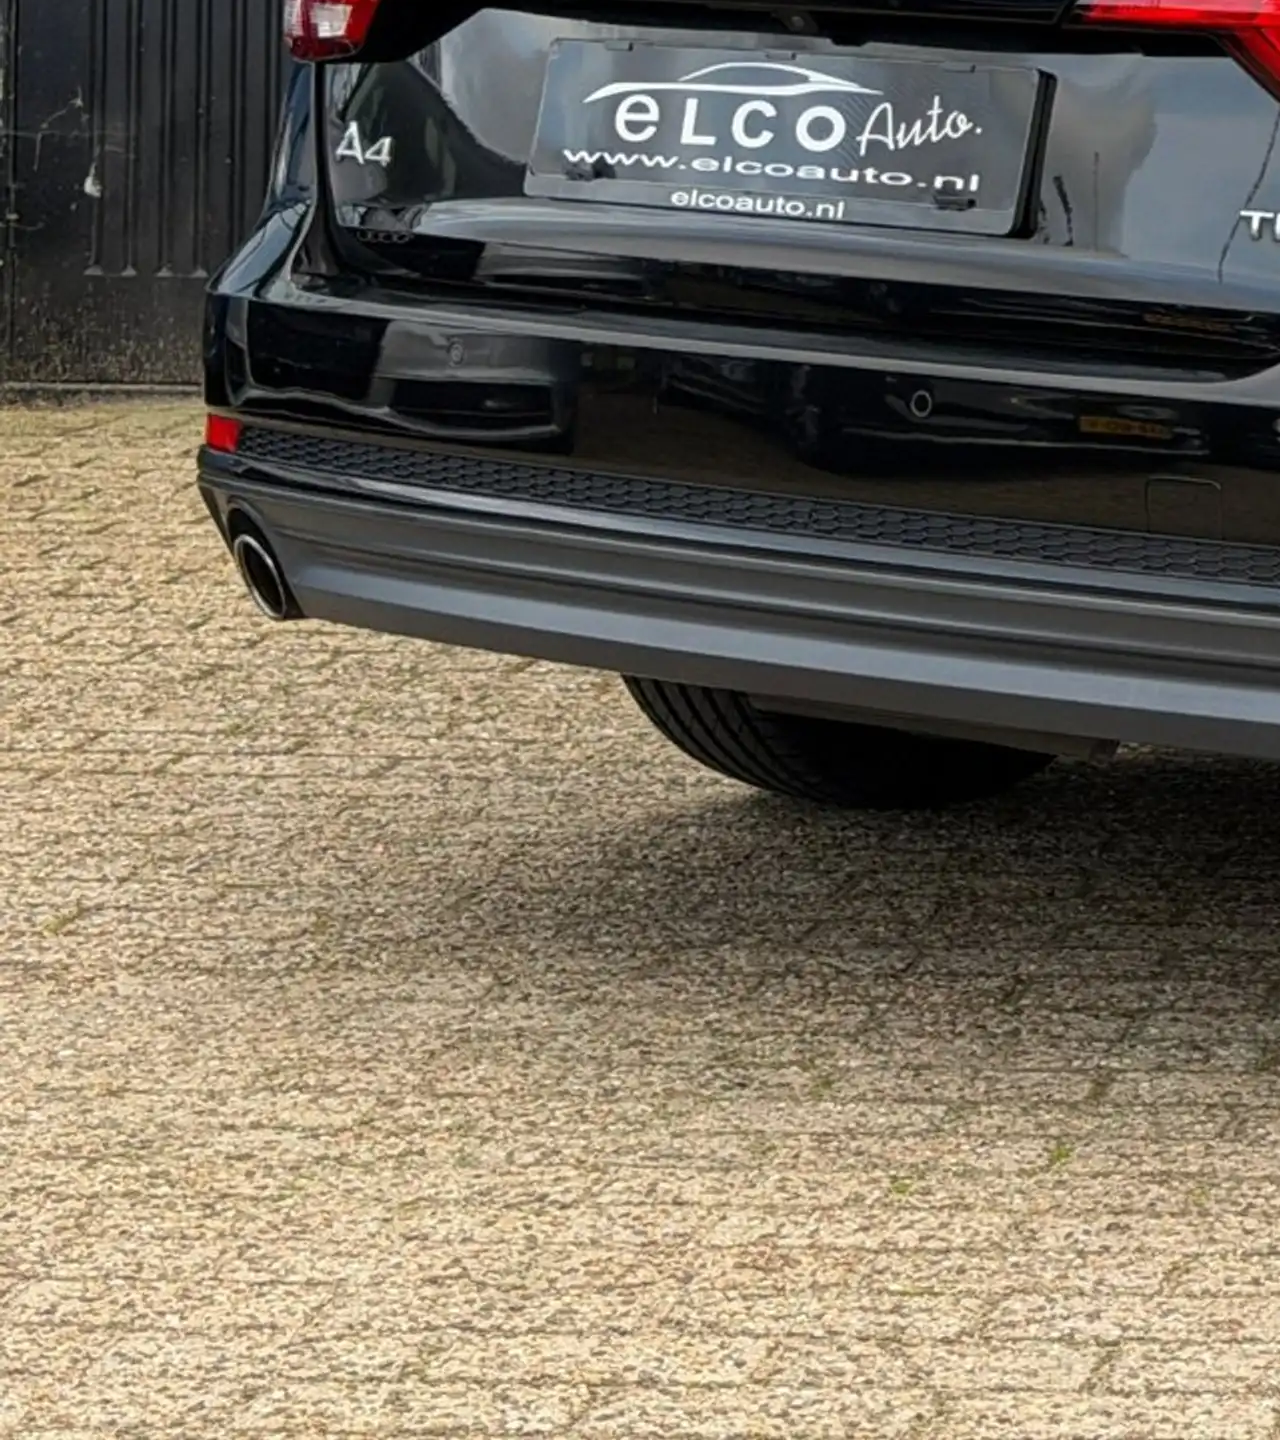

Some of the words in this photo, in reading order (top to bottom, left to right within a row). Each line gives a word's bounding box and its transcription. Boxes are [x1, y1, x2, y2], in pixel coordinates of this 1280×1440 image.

[335, 121, 393, 169] A4
[563, 149, 980, 192] www.elcoauto.nl
[670, 188, 845, 220] elcoauto.nl
